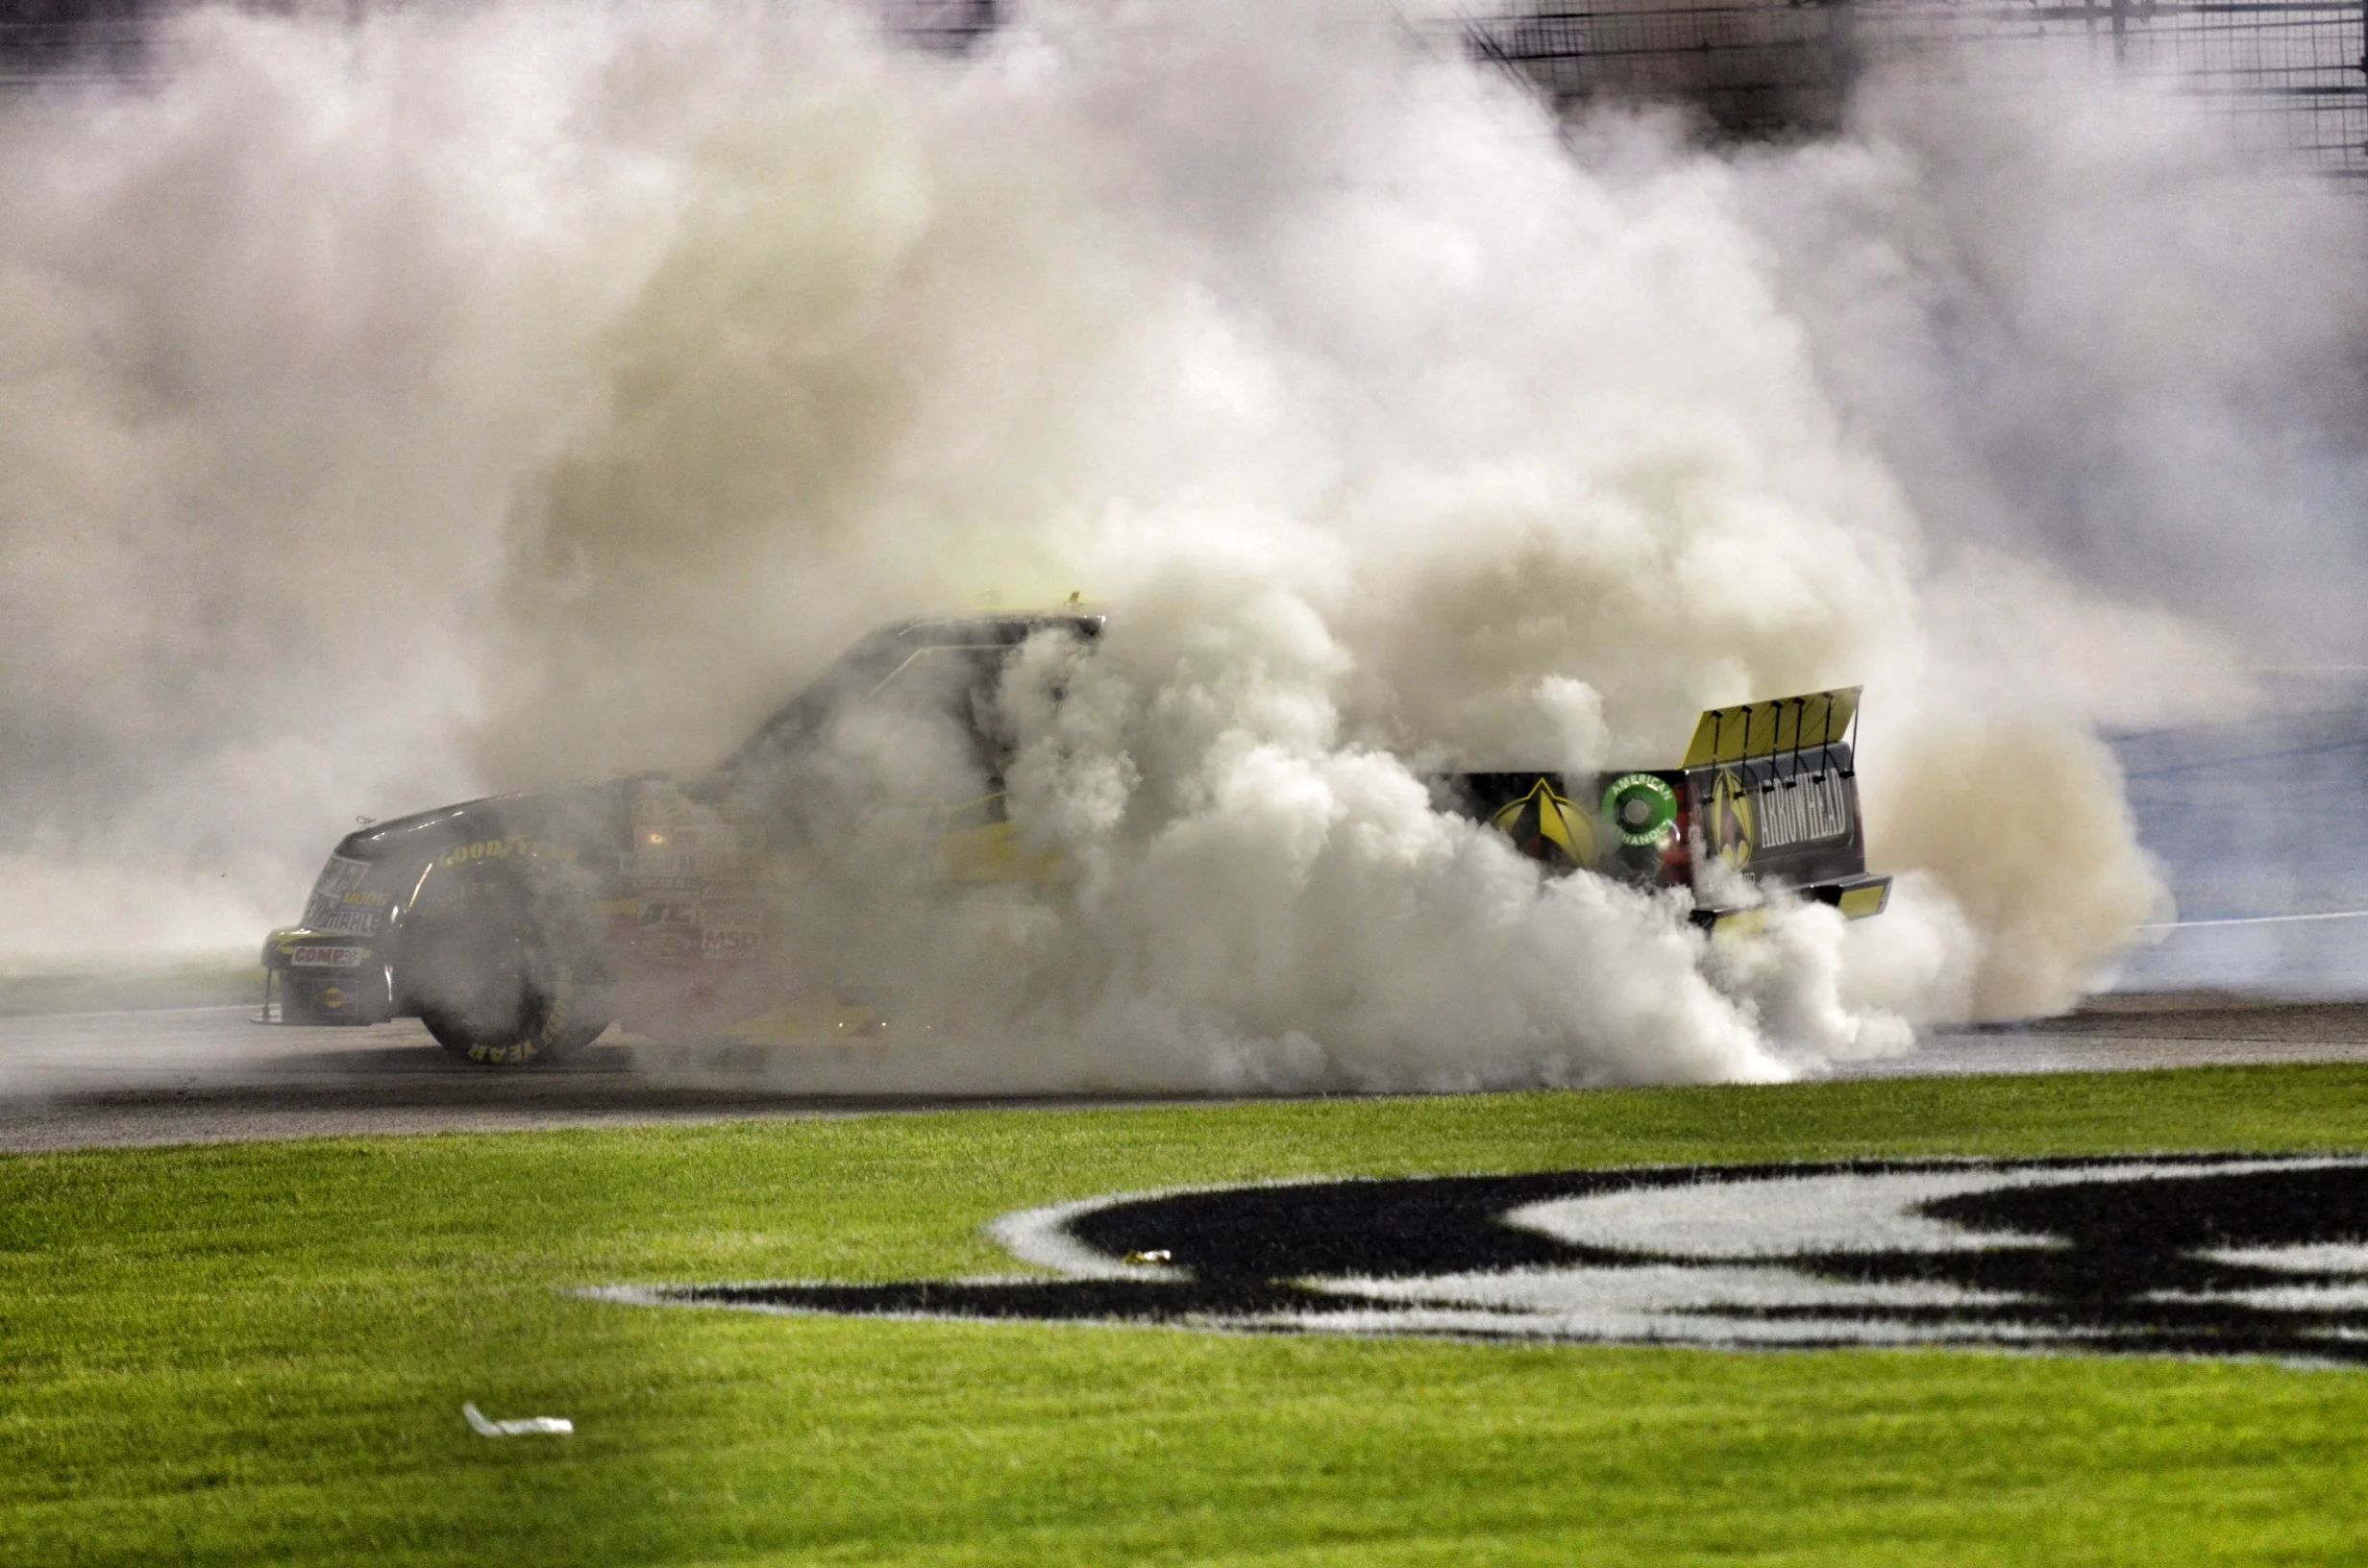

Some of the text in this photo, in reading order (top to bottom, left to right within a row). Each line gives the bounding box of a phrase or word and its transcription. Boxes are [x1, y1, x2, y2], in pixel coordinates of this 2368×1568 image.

[1612, 773, 1673, 800] AMERICAN
[1758, 768, 1846, 848] ARROWHEAD
[1616, 818, 1665, 845] HANOL
[705, 930, 758, 949] MSD
[294, 947, 345, 963] COMP
